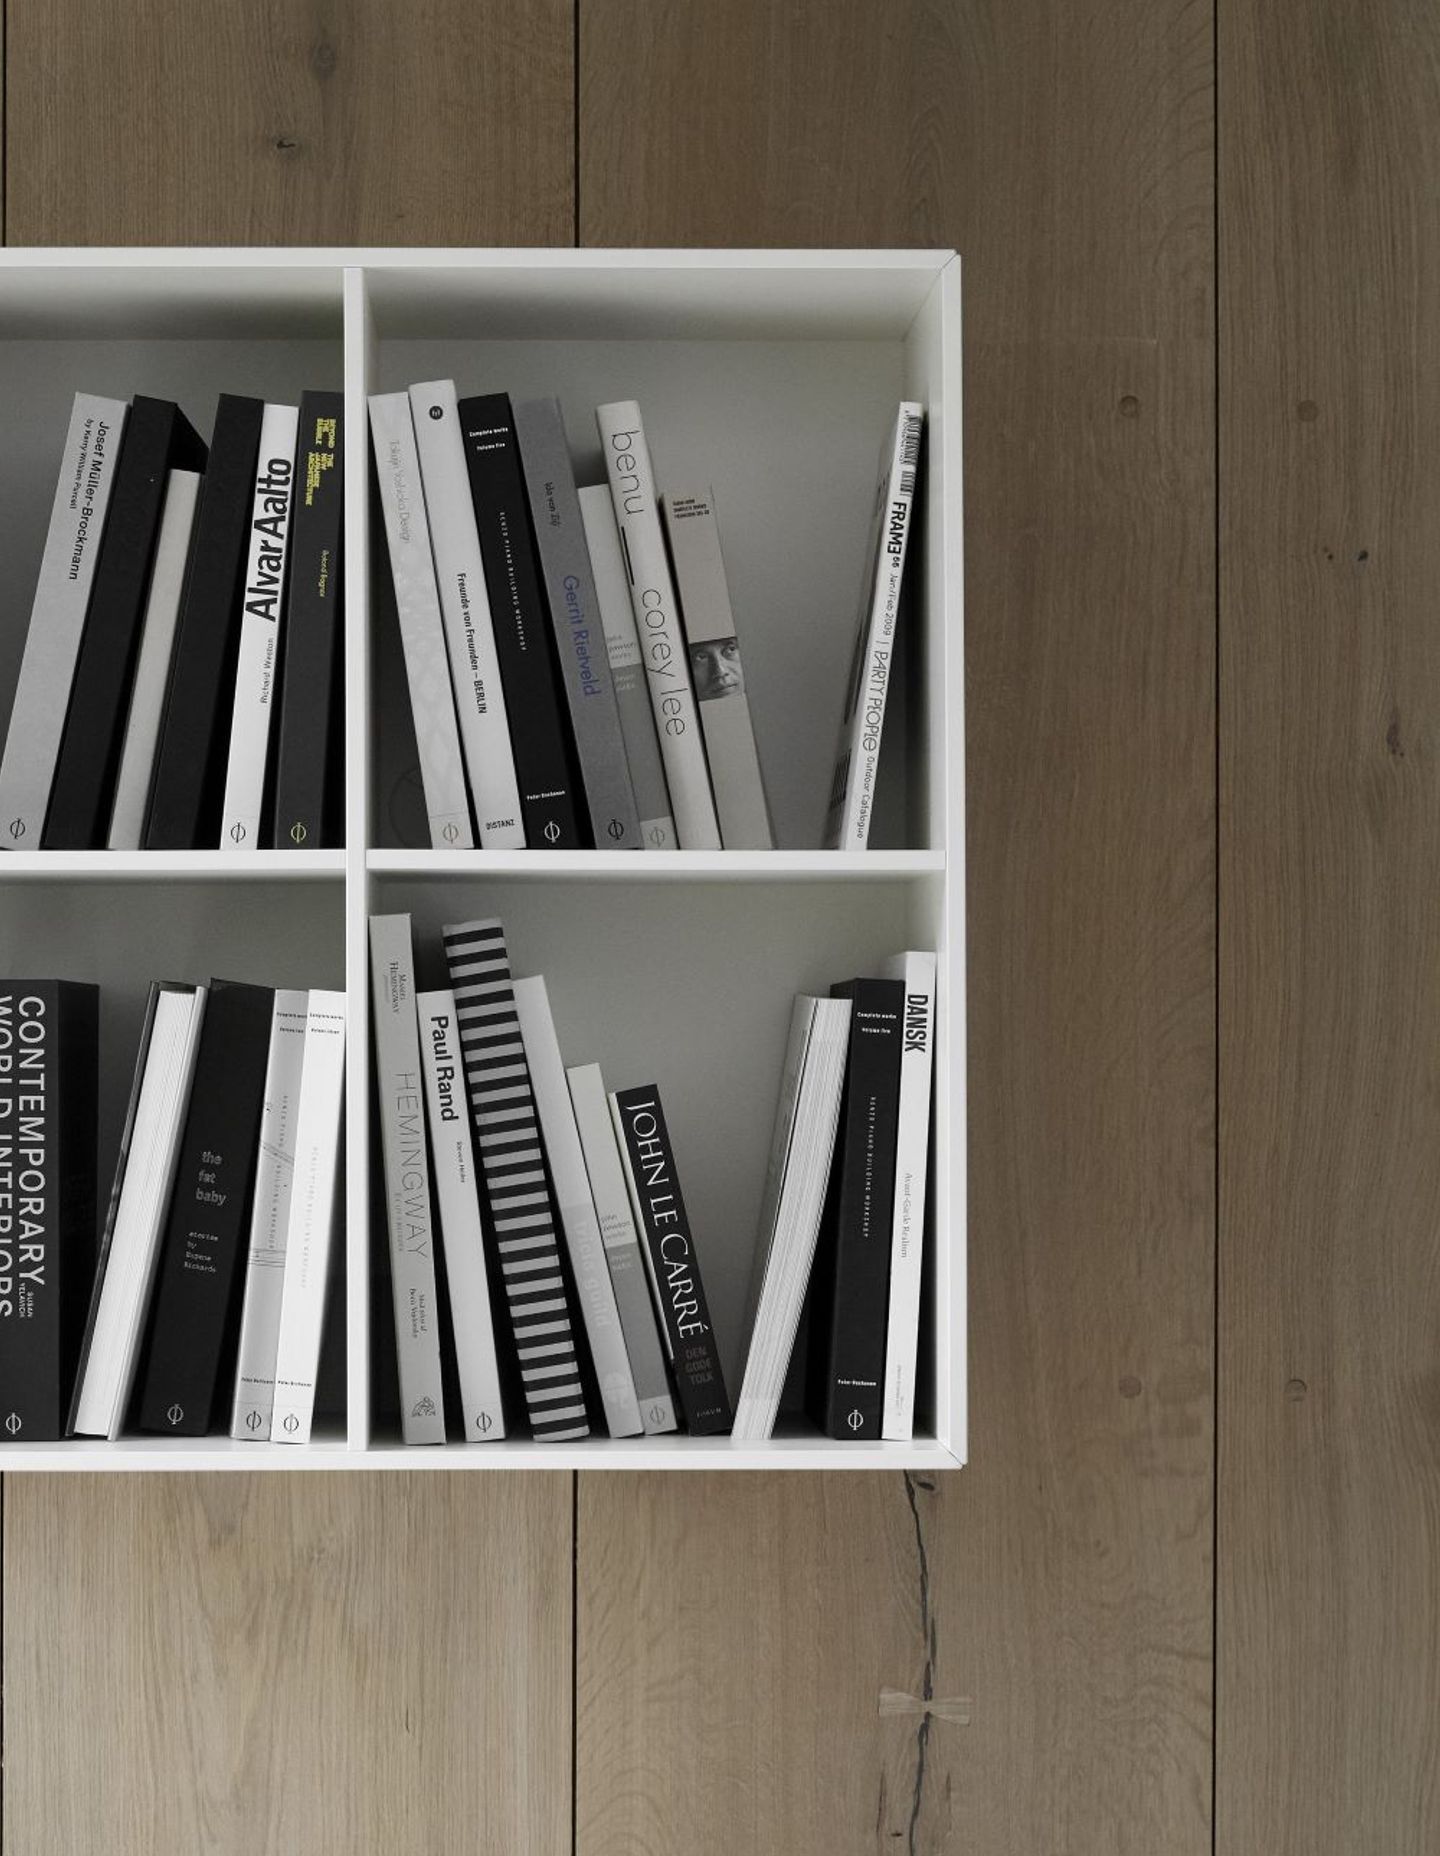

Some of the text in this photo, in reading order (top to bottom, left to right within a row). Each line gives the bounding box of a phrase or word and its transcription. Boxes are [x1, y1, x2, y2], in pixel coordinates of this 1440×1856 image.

[81, 430, 91, 451] Kerry
[85, 418, 94, 428] by
[70, 421, 109, 579] Josef Müller-Brockmann
[611, 430, 644, 517] benu
[246, 457, 293, 621] Alvar Aalto
[457, 573, 487, 713] Freunde von Freunden BERLIN
[564, 575, 600, 696] Gerrit Rietveld
[883, 613, 894, 636] 2009
[642, 589, 687, 737] corey lee
[870, 651, 889, 695] PARTY
[864, 756, 875, 792] Outdoor
[857, 794, 870, 838] Catalogue
[905, 994, 929, 1054] DANSK
[430, 1015, 459, 1123] Paul Rand
[18, 996, 46, 1286] CONTEMPORARY
[198, 1170, 216, 1185] fat
[201, 1150, 222, 1166] the
[395, 1072, 428, 1260] HEMINGWAY
[195, 1188, 227, 1206] baby
[626, 1099, 710, 1339] JOHN LE CARRÉ
